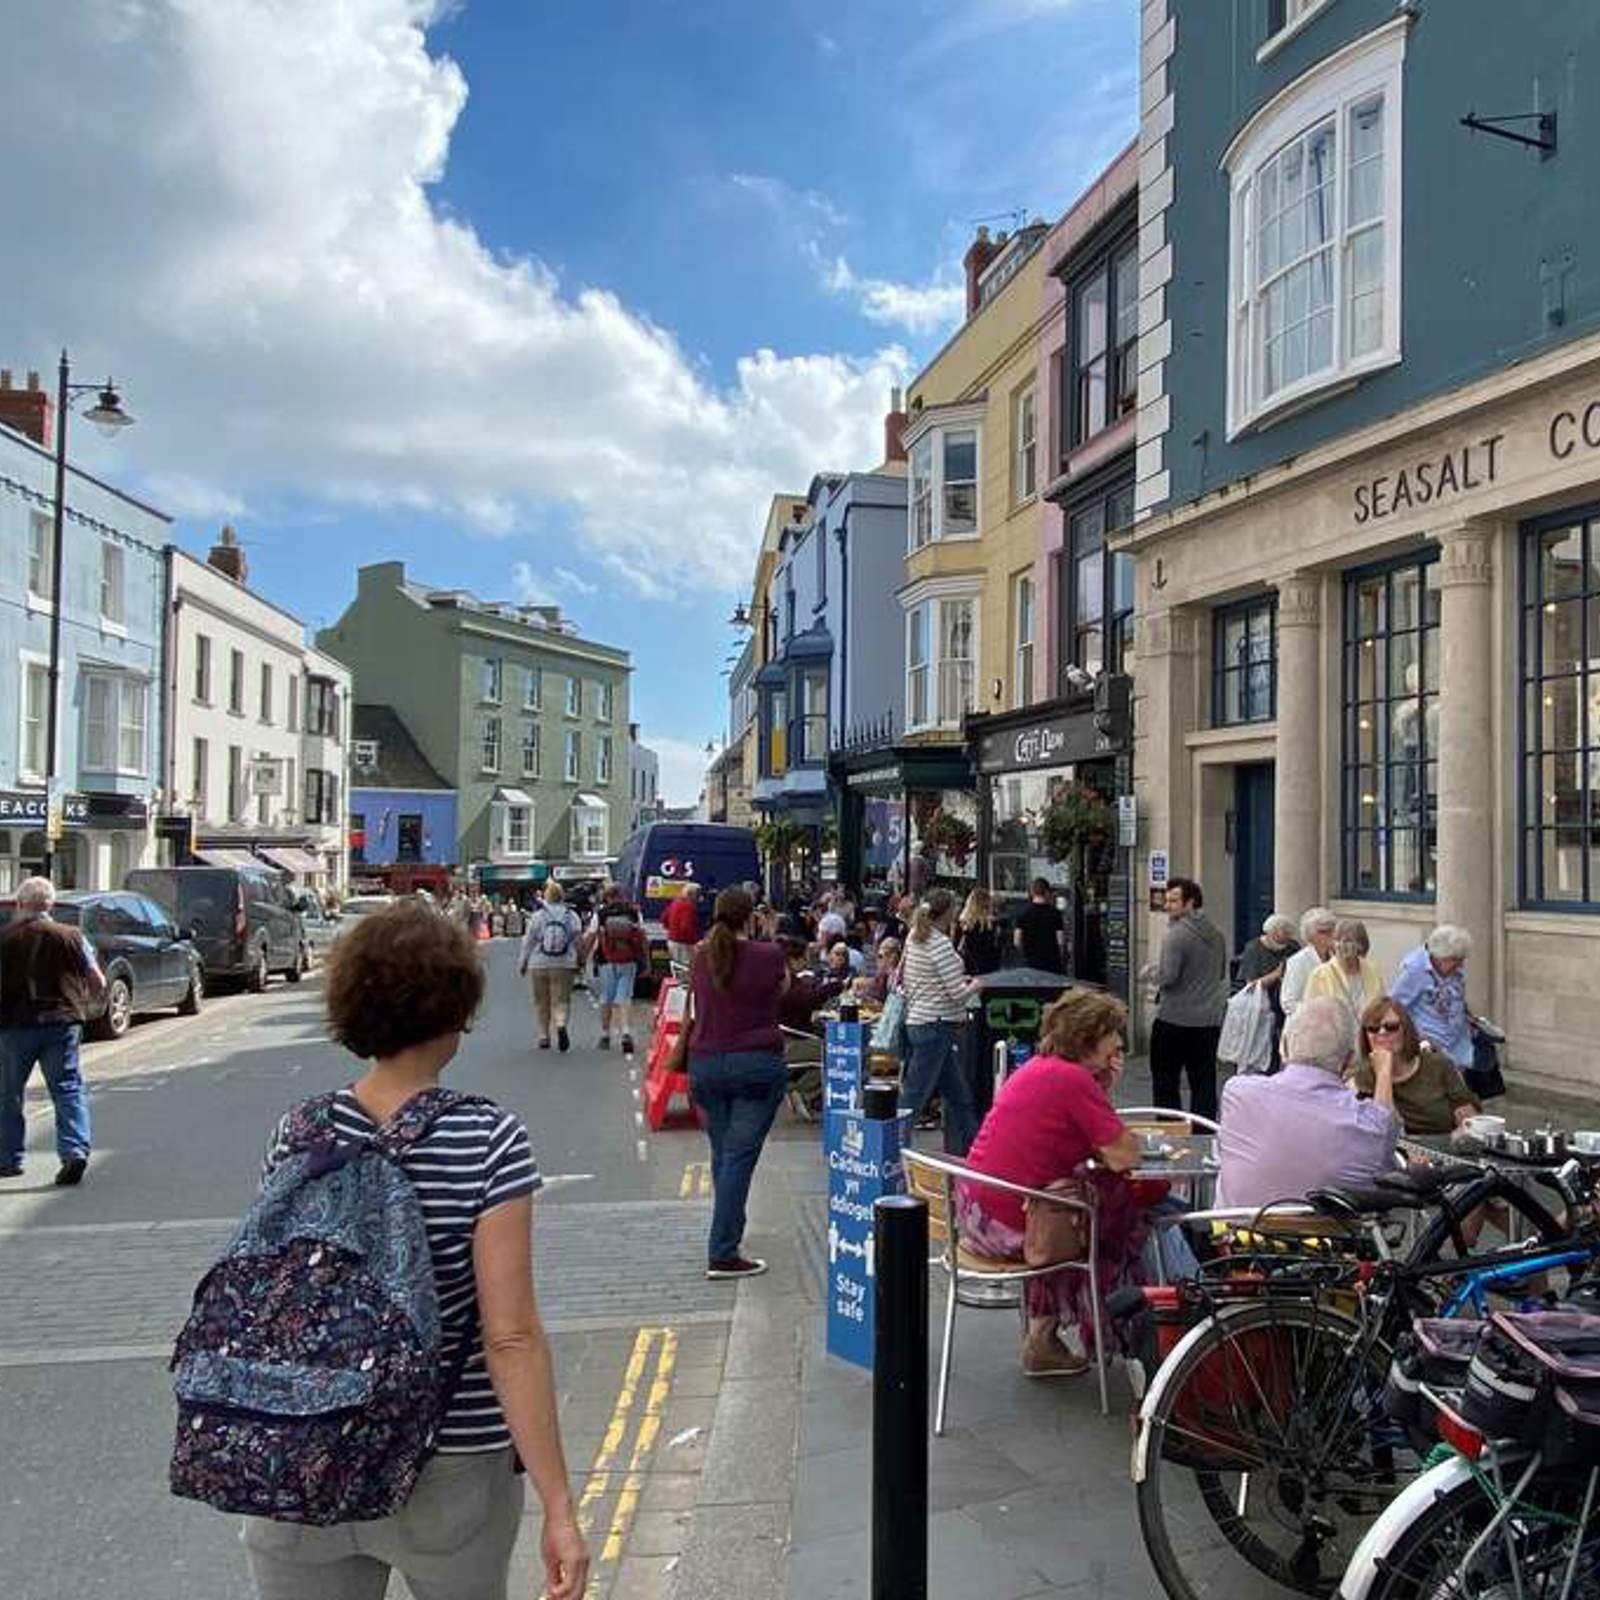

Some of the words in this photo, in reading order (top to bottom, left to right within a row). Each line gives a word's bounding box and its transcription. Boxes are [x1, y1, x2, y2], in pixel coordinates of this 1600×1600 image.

[1354, 434, 1504, 524] SEASALT
[830, 1150, 879, 1178] Cadwch
[844, 1180, 860, 1195] yn
[835, 1273, 866, 1303] Stay
[836, 1300, 864, 1322] safe
